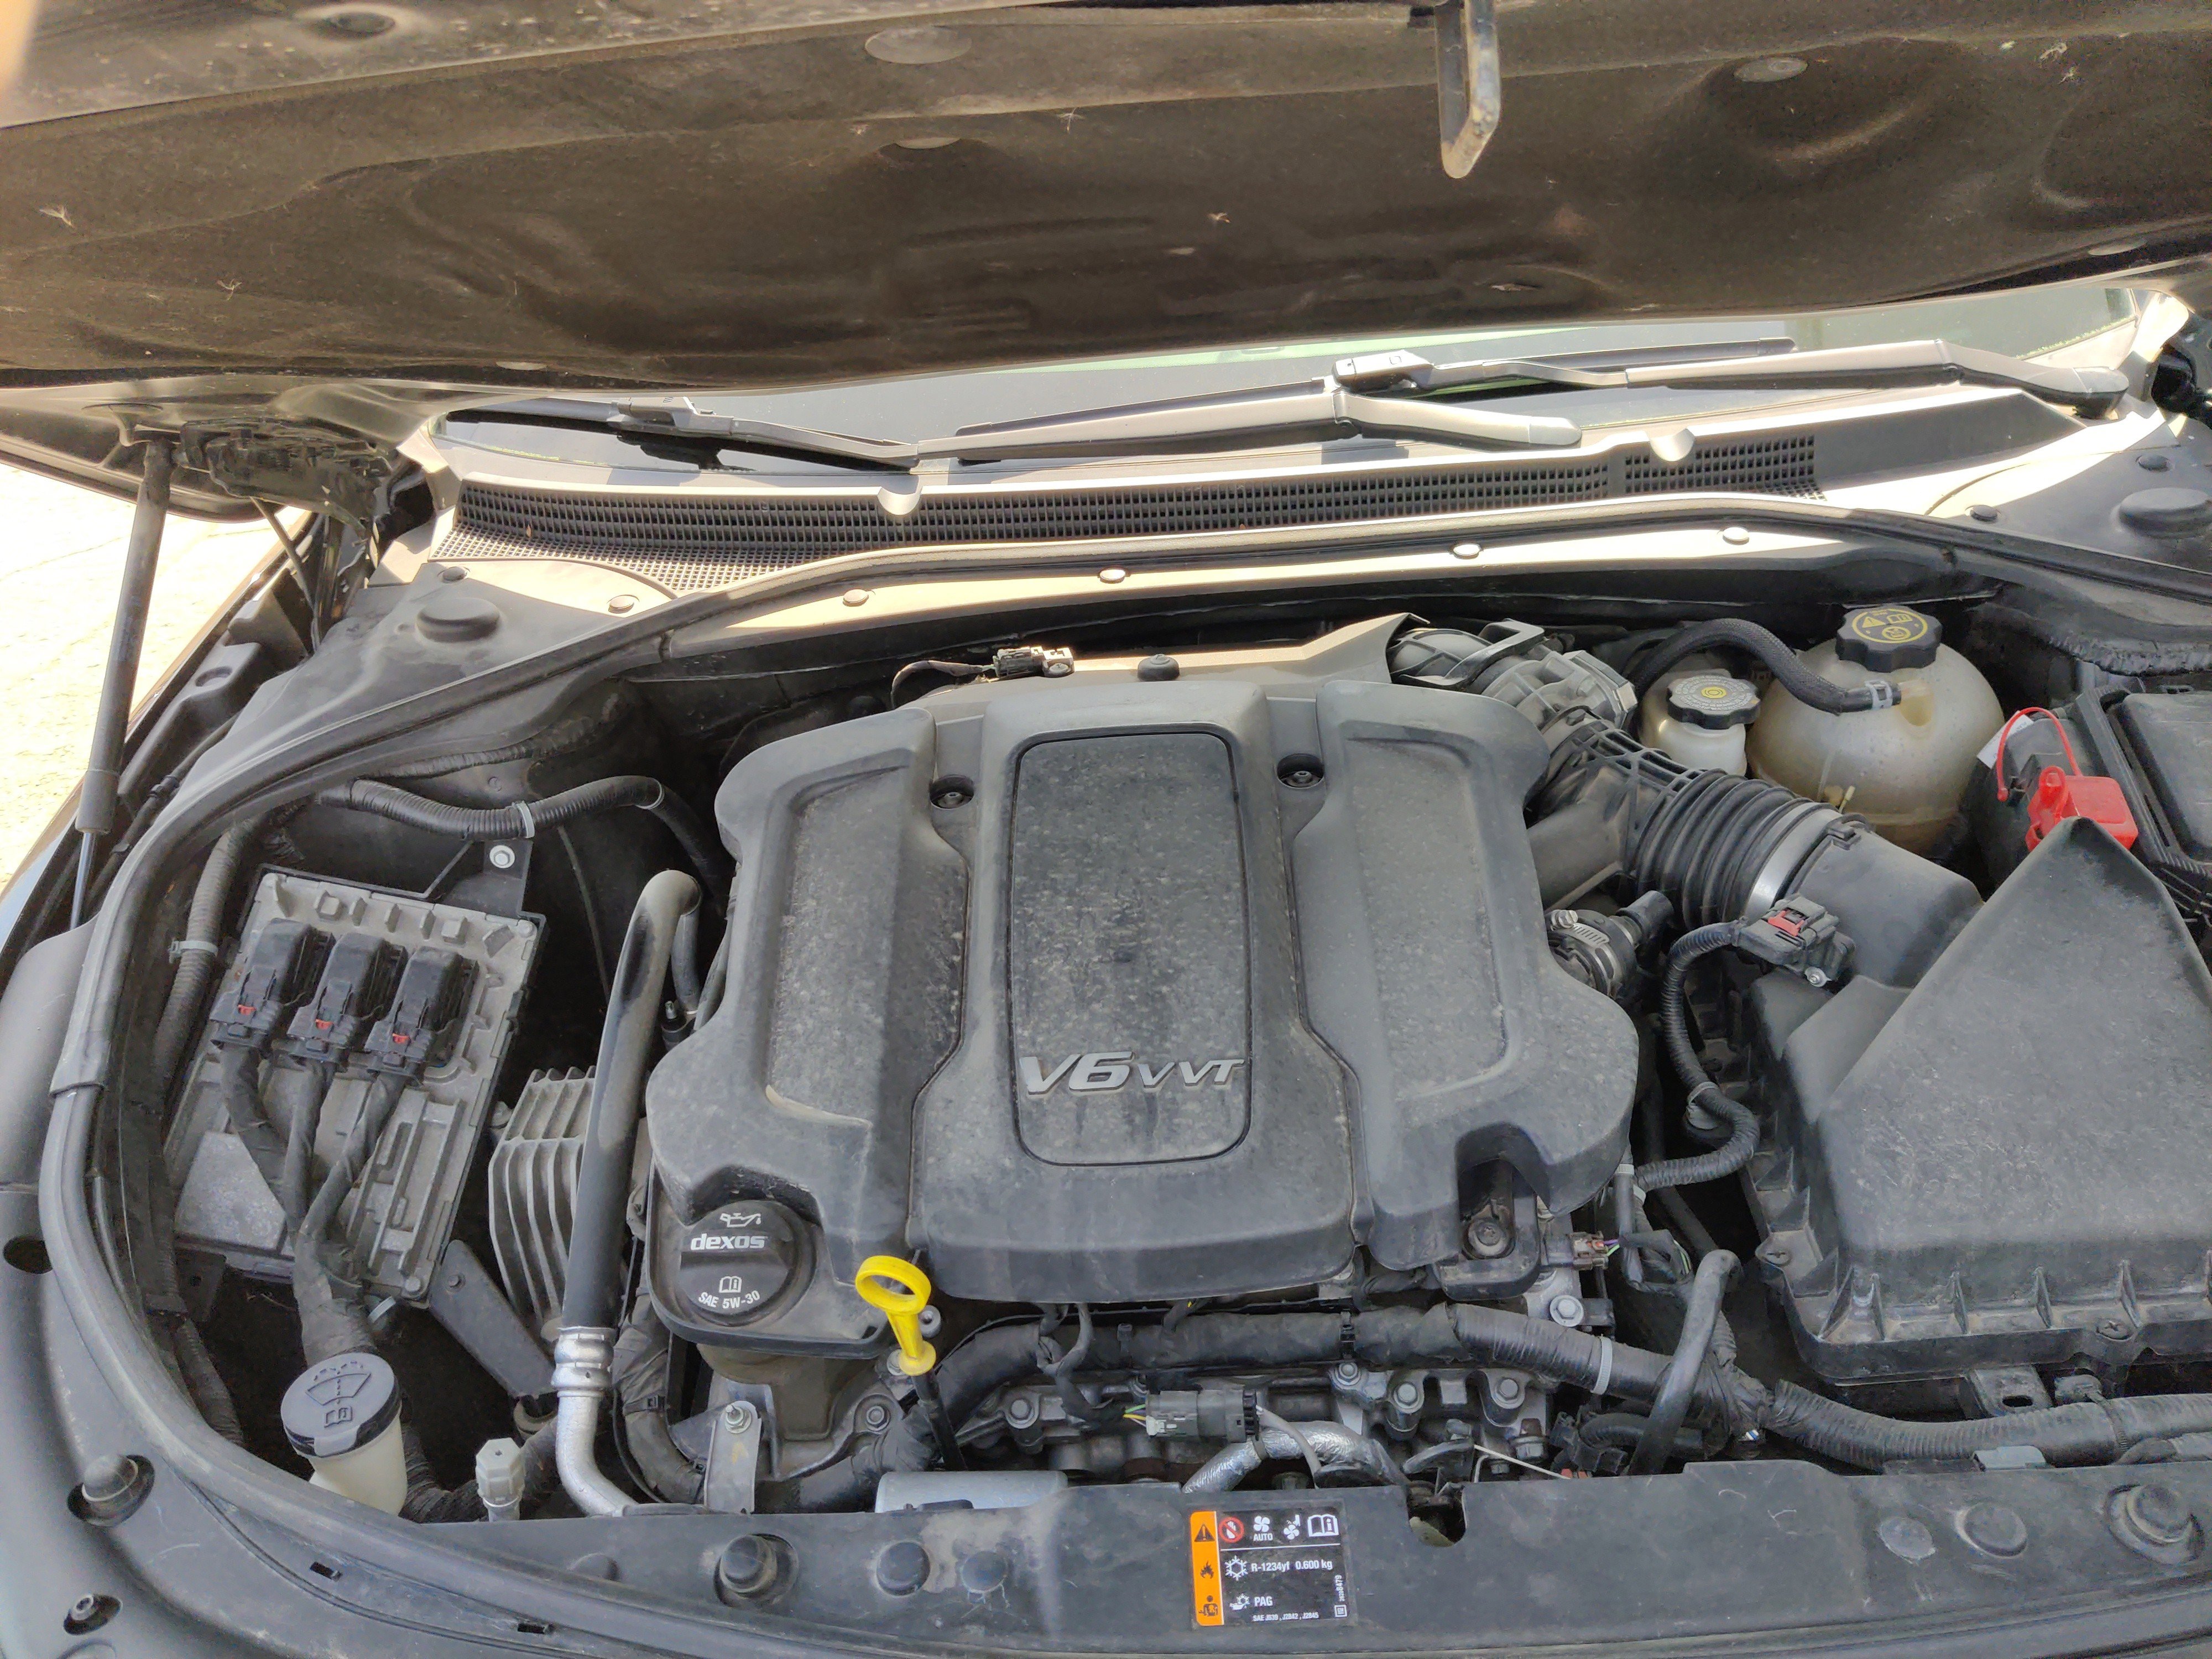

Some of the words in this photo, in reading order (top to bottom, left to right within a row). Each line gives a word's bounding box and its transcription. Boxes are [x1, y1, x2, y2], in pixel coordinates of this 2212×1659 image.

[1020, 1051, 1134, 1095] V6
[1138, 1058, 1245, 1088] VVT
[691, 1233, 766, 1250] dexos
[698, 1292, 719, 1308] SAE
[722, 1290, 760, 1309] 5W-30
[1253, 1533, 1273, 1542] AUTO
[1251, 1561, 1290, 1572] R-1234yf
[1295, 1560, 1319, 1570] 0.600
[1321, 1559, 1333, 1571] kg
[1254, 1596, 1273, 1607] PAG
